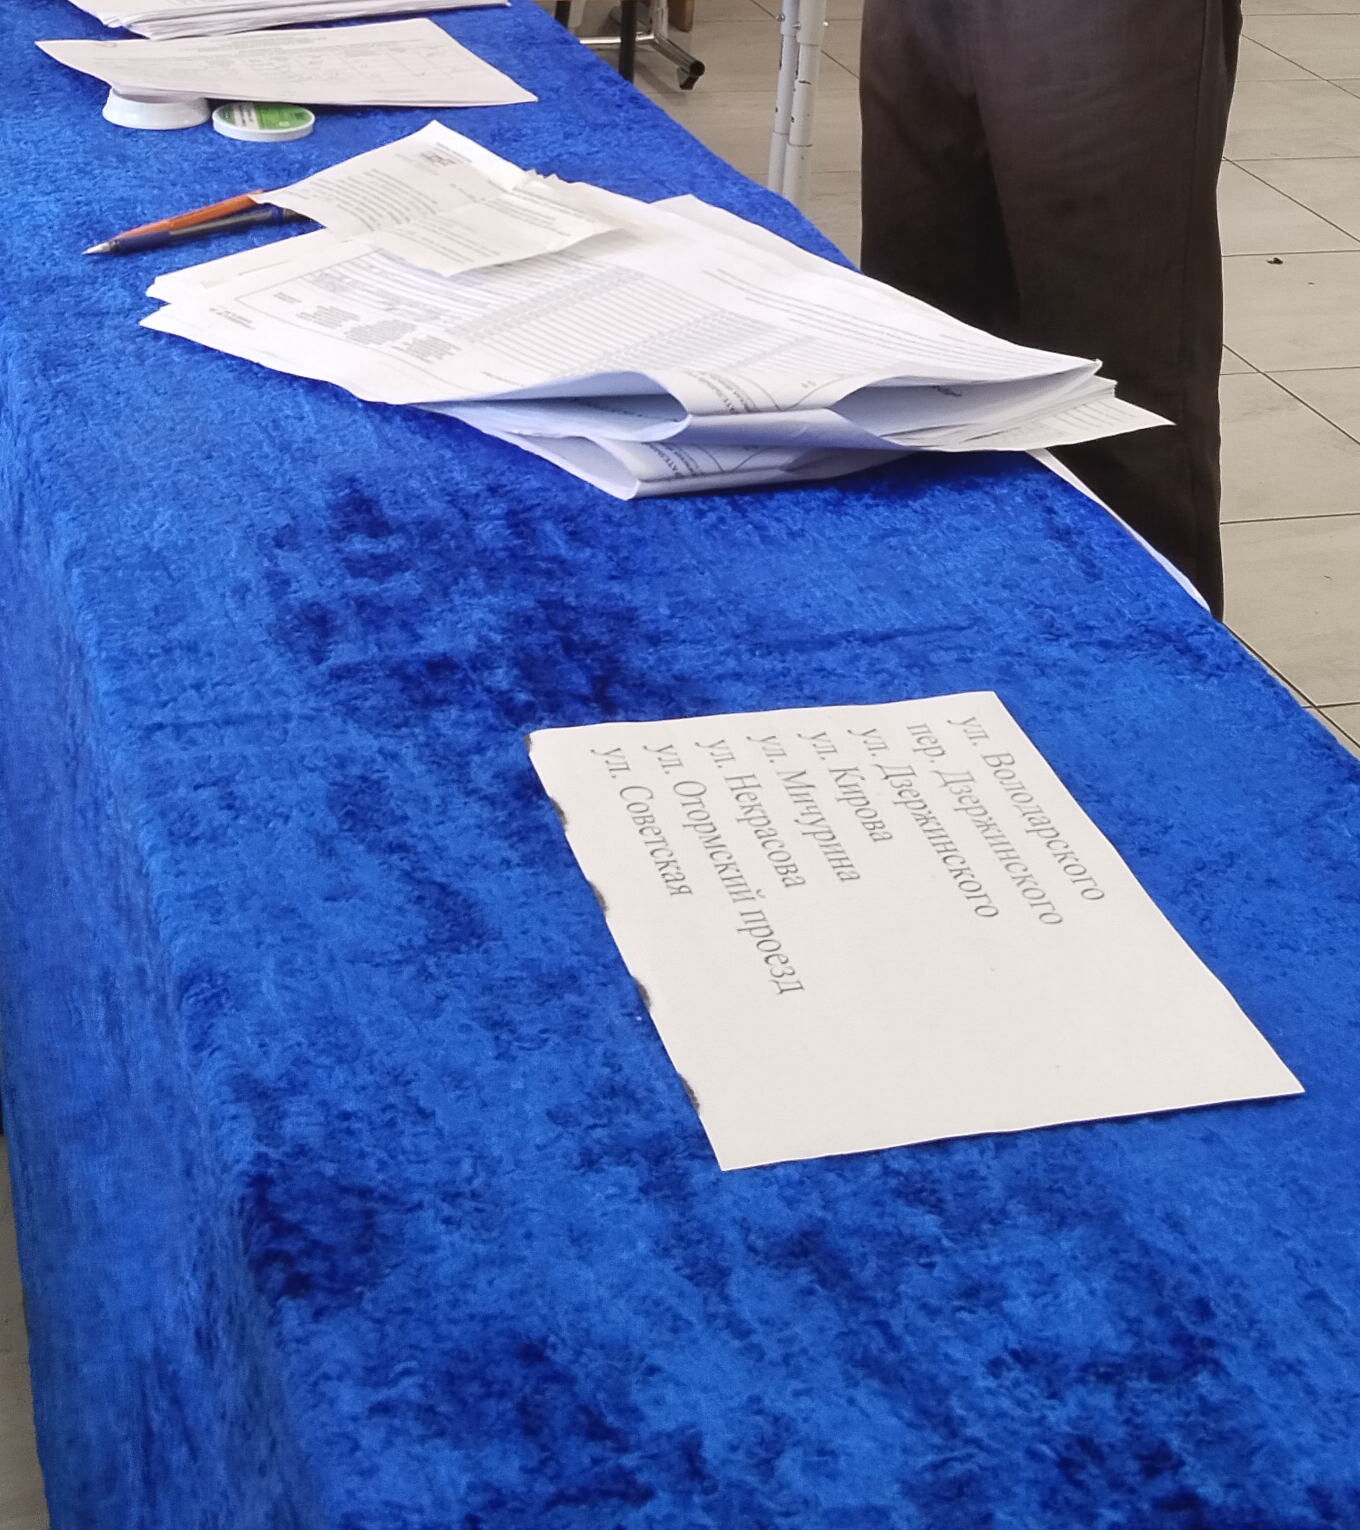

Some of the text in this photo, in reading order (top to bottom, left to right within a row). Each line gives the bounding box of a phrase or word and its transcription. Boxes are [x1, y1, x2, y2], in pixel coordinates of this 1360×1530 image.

[590, 747, 693, 896] ул. Советская
[642, 744, 806, 995] ул. Отормский проезд
[695, 739, 806, 888] ул. Некрасова
[746, 734, 861, 883] ул. Мичурина
[797, 731, 893, 843] ул. Кирова
[847, 727, 999, 919] ул. Дзержинского
[907, 723, 1063, 925] пер. Дзержинского
[947, 716, 1105, 901] ул. Володарского
